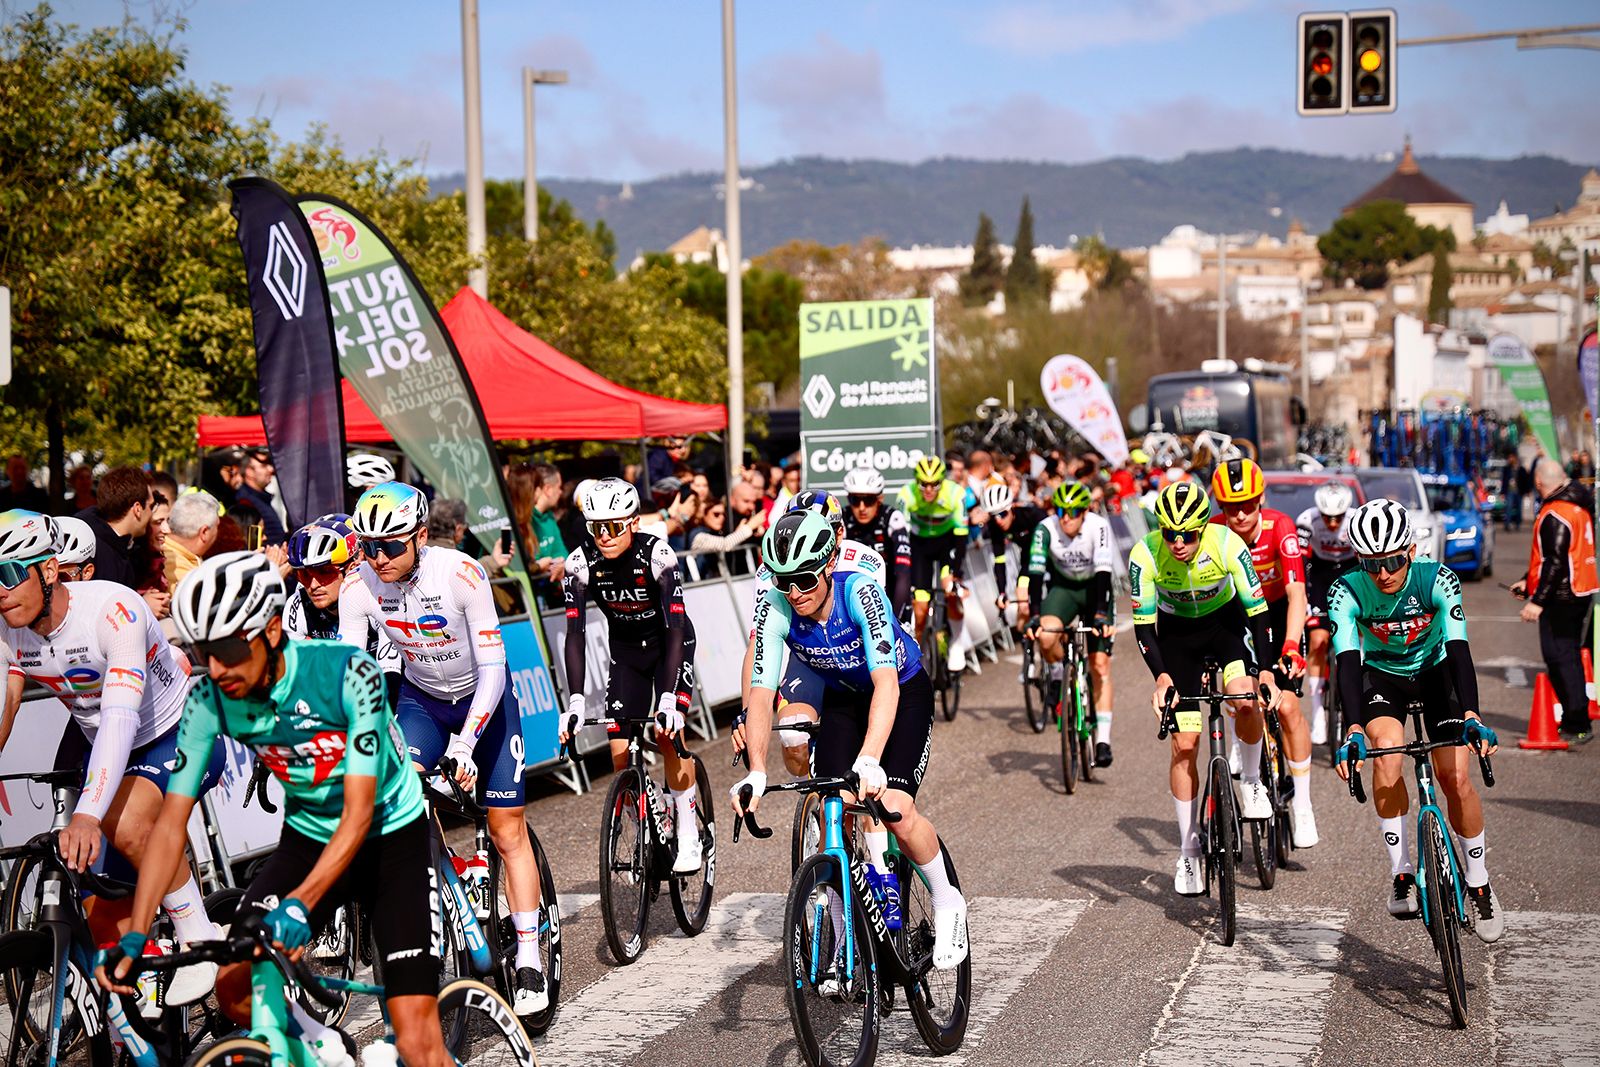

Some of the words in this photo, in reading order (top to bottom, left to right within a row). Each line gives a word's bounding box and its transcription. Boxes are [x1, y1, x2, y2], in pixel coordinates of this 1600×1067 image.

[806, 305, 922, 333] SALIDA
[810, 446, 924, 473] Córdoba
[860, 553, 882, 569] BORA
[601, 588, 649, 602] UAE
[1437, 566, 1461, 596] ERN
[857, 586, 882, 641] MONDIALE
[866, 583, 884, 613] AG2R
[878, 612, 888, 629] LA
[755, 600, 772, 661] DECATHLON
[1371, 615, 1432, 631] KERN
[415, 649, 462, 663] VENDÉE
[254, 734, 346, 759] KERN
[645, 774, 667, 845] COLNAGO
[427, 866, 441, 957] KERN
[850, 855, 866, 892] VAN
[863, 890, 890, 942] RYSEL
